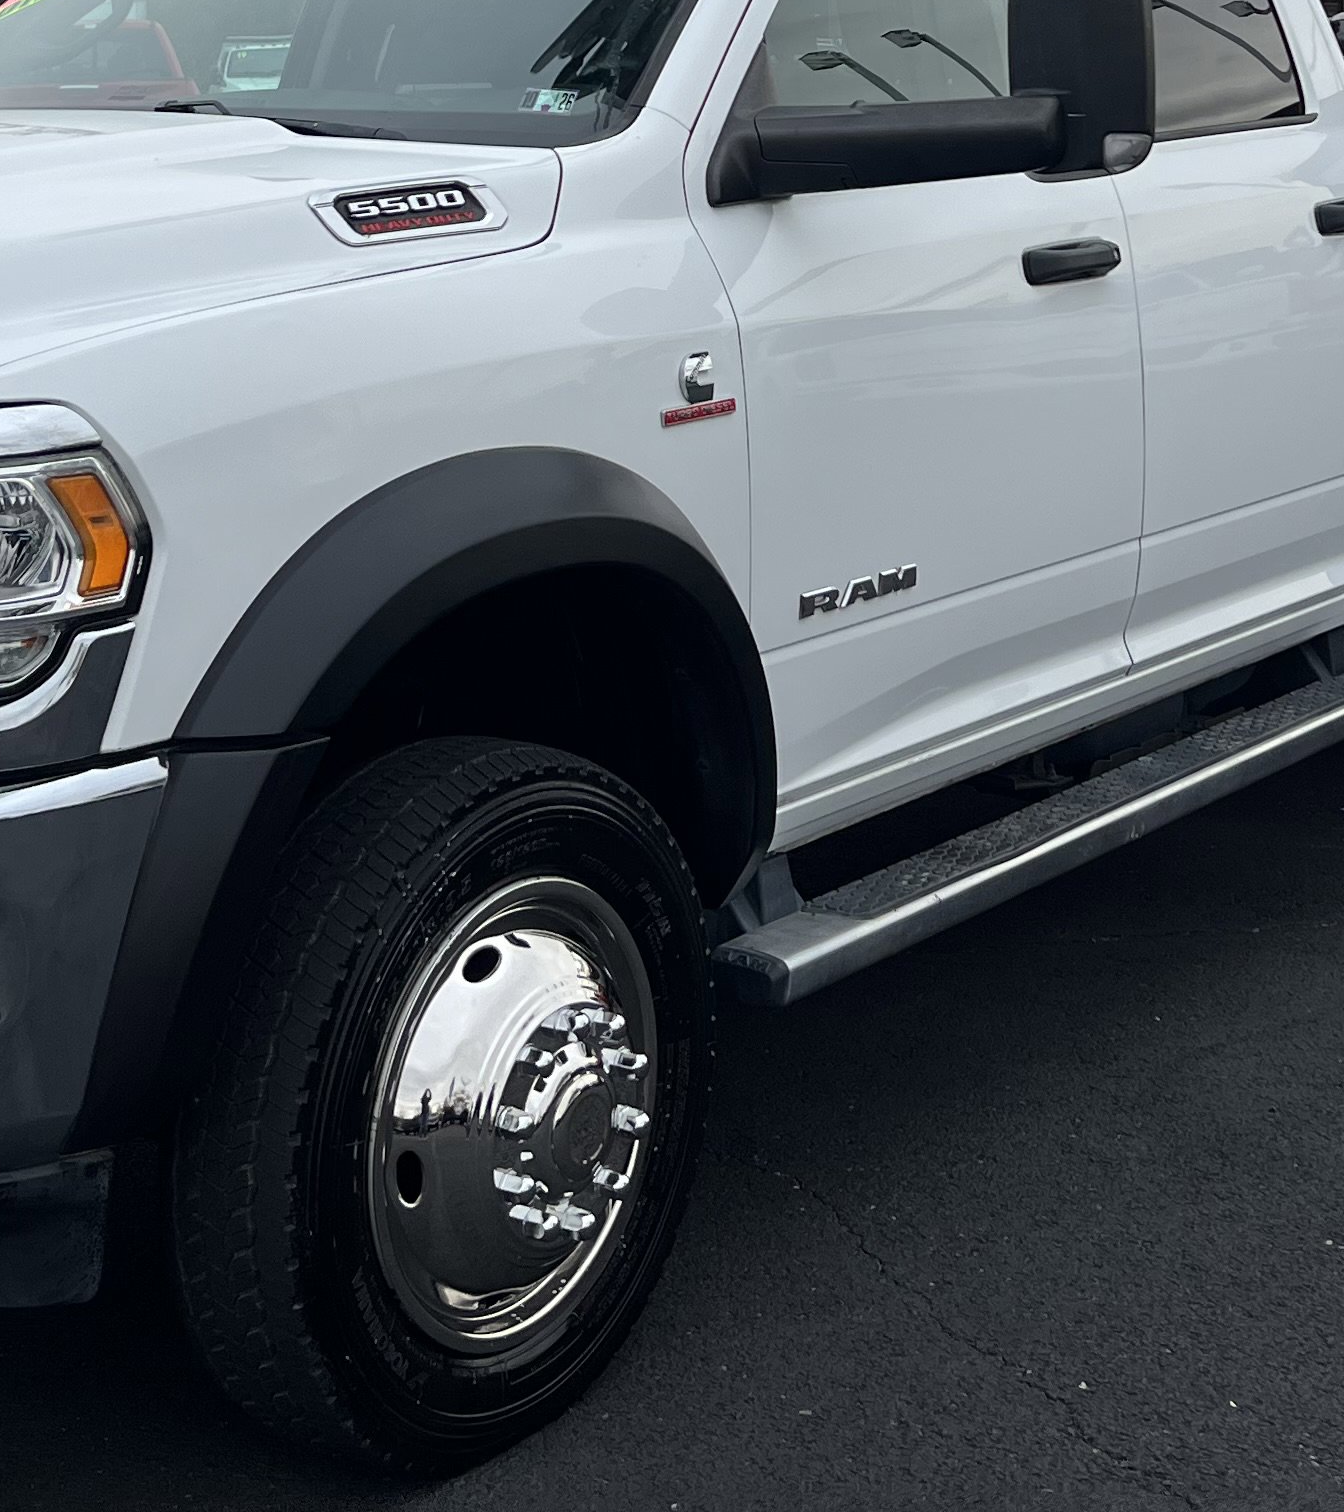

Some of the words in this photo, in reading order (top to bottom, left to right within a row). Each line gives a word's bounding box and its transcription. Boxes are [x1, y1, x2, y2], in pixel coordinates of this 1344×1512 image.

[558, 92, 575, 110] 26
[347, 189, 466, 218] 5500
[361, 217, 422, 233] HEAVY
[427, 211, 476, 225] DUTY
[799, 563, 918, 620] RAM
